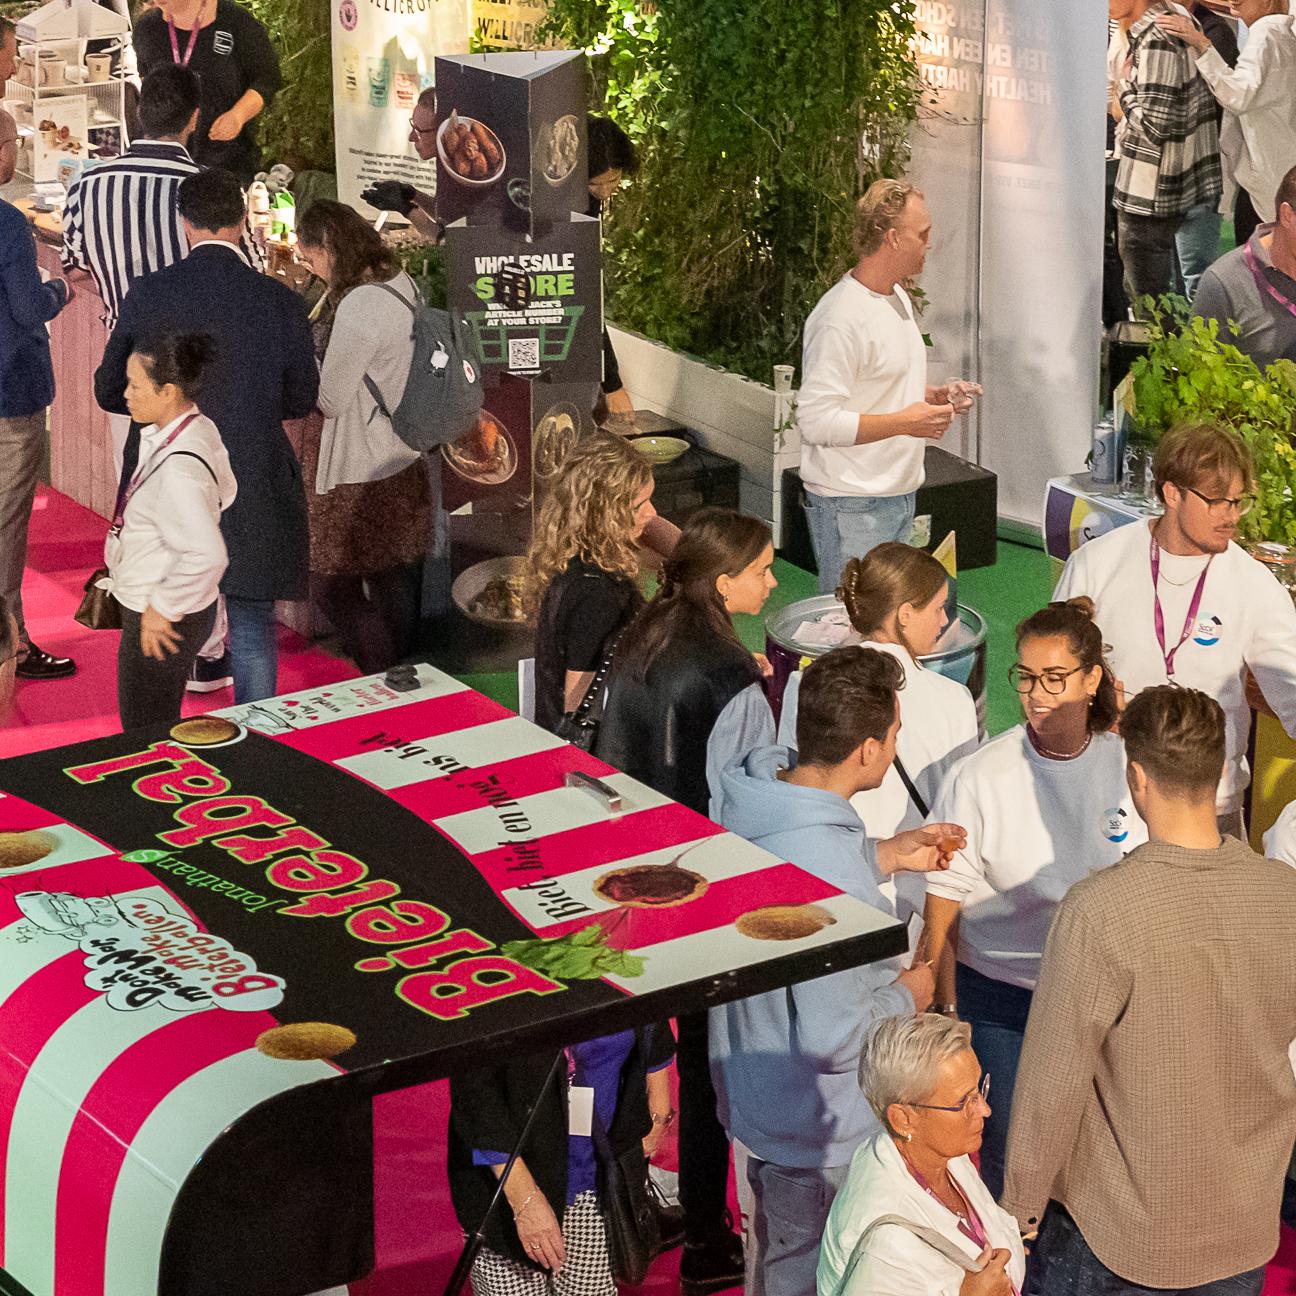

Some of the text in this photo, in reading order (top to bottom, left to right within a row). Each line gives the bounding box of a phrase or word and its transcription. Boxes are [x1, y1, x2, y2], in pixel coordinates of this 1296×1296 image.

[474, 253, 575, 275] WHOLESALE
[359, 731, 430, 760] biet
[498, 812, 533, 834] en
[497, 838, 544, 872] biet
[62, 741, 568, 1021] Bieterbal
[140, 965, 213, 1003] make
